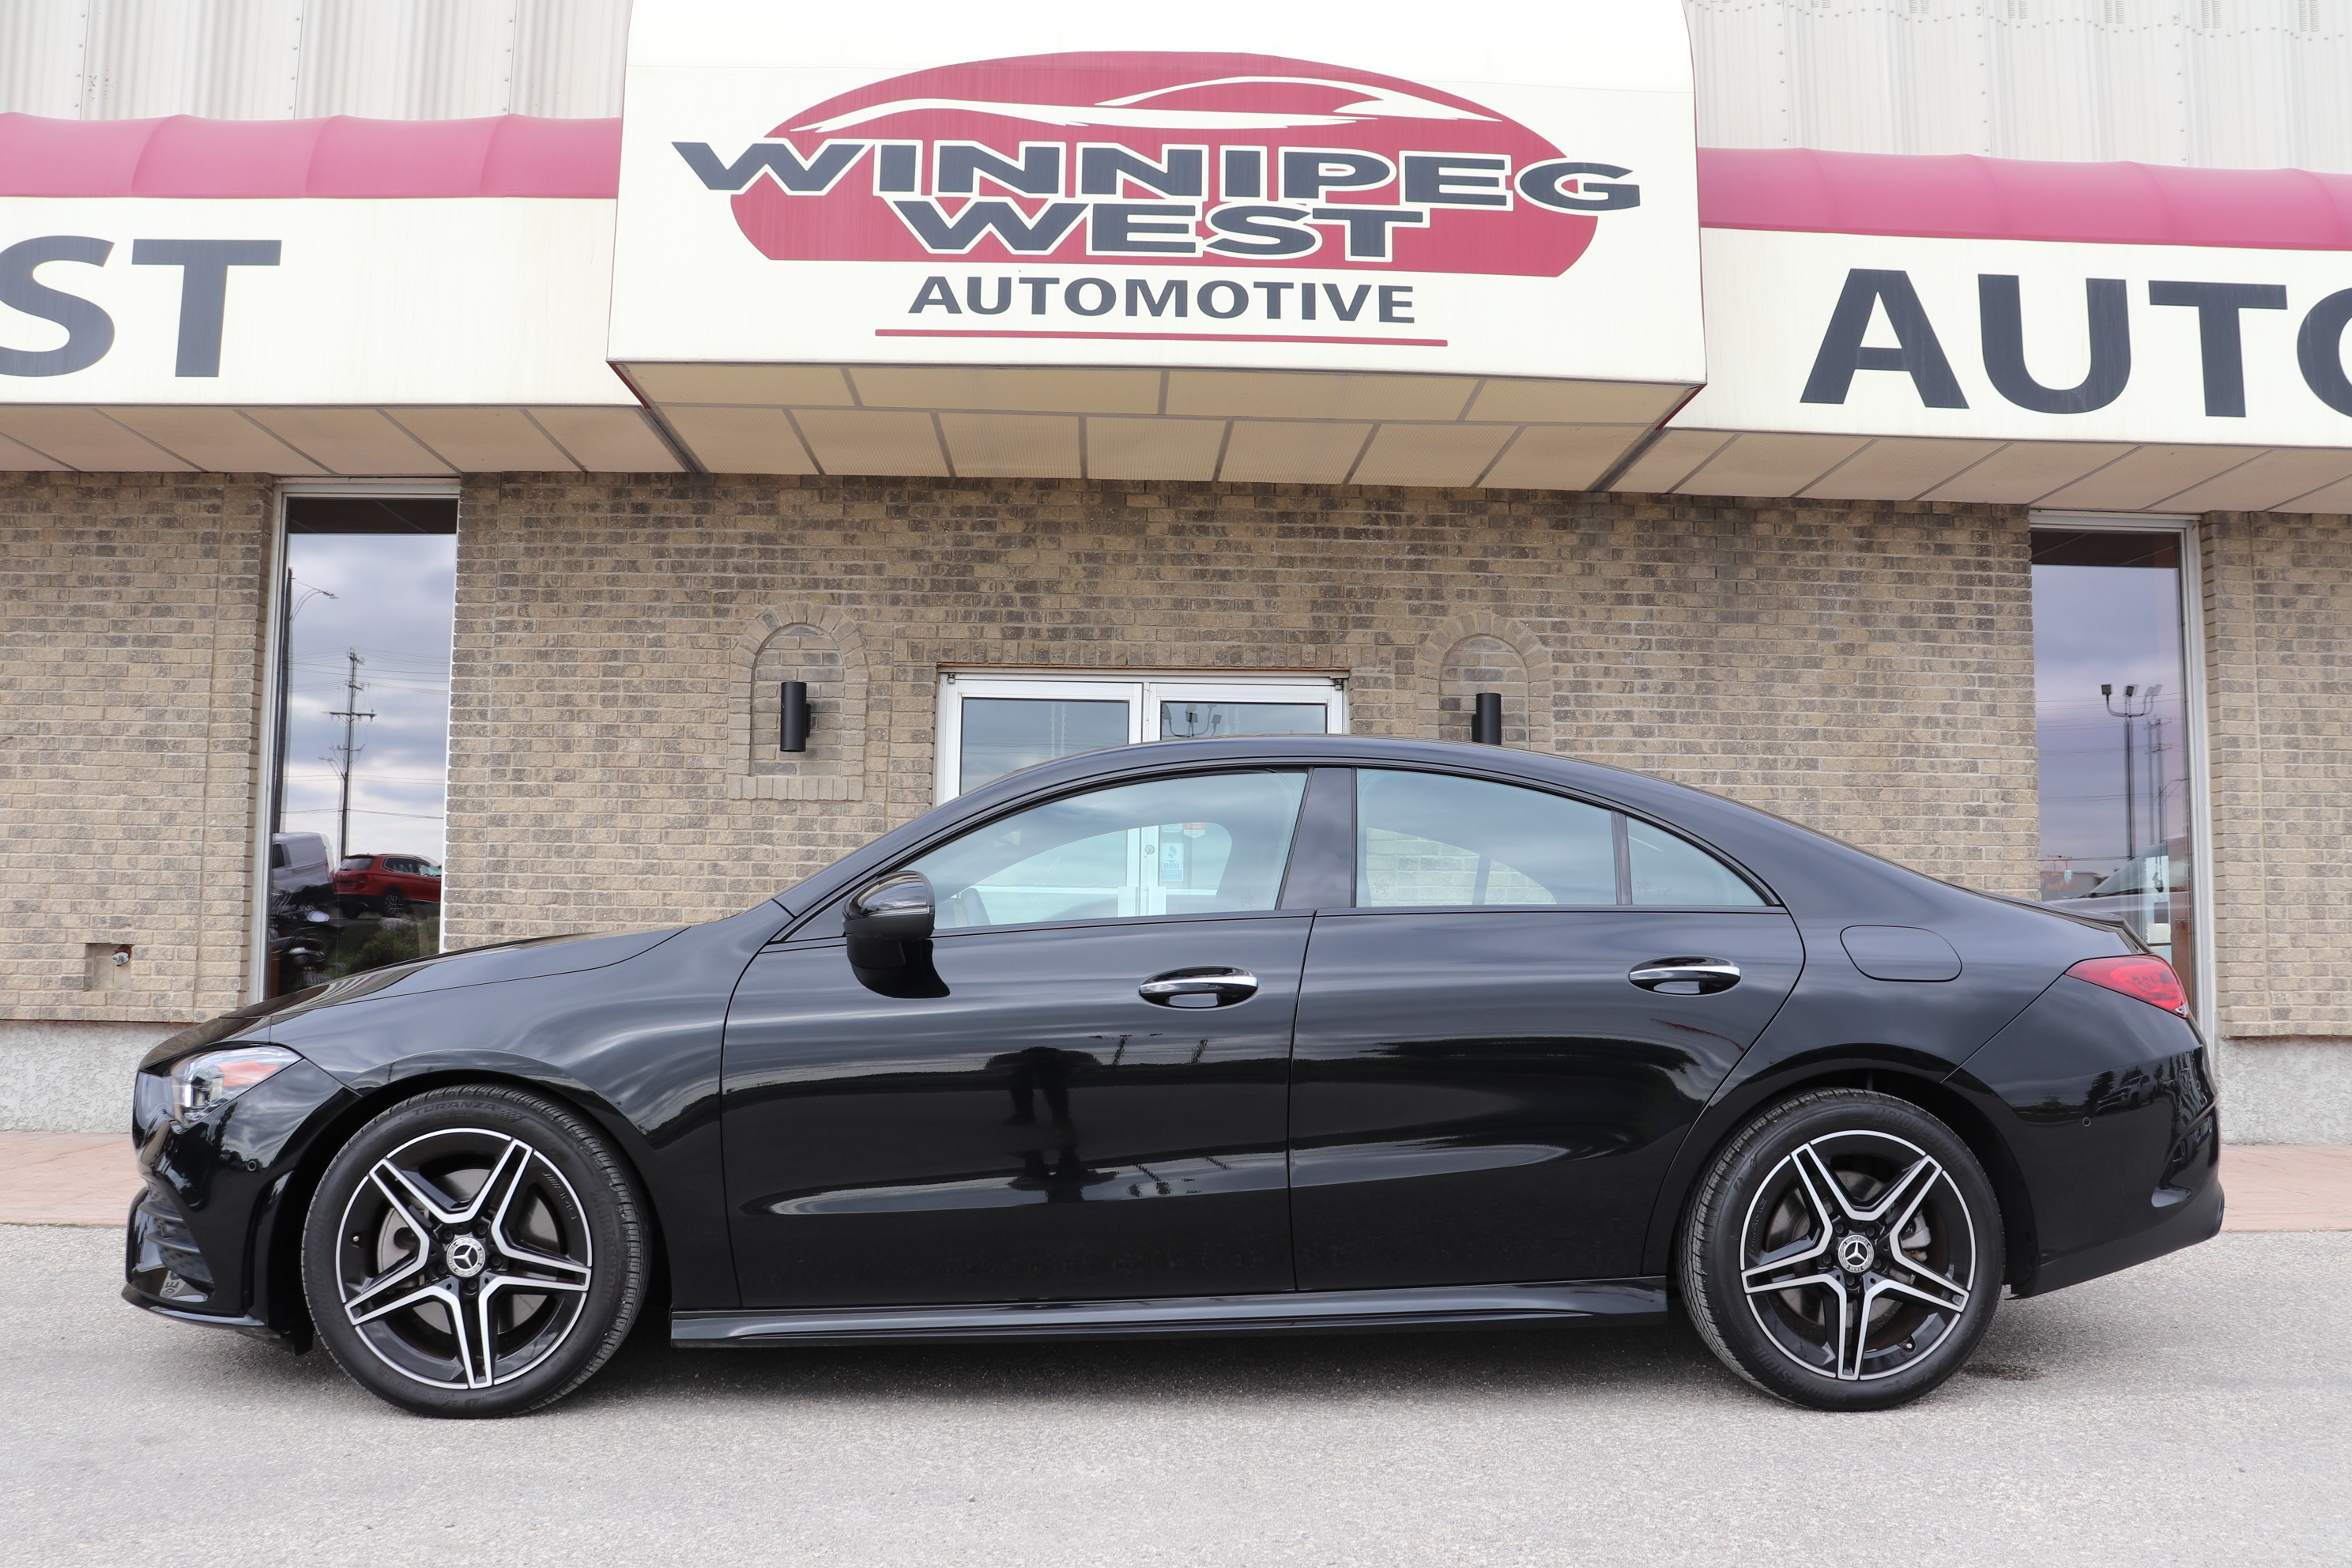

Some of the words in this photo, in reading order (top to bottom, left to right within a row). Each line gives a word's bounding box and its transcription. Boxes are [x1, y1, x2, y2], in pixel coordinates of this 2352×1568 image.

[672, 141, 1641, 212] WINNIPEG
[893, 201, 1424, 258] WEST
[908, 276, 1415, 324] AUTOMOTIVE
[411, 1101, 496, 1116] TURANZA
